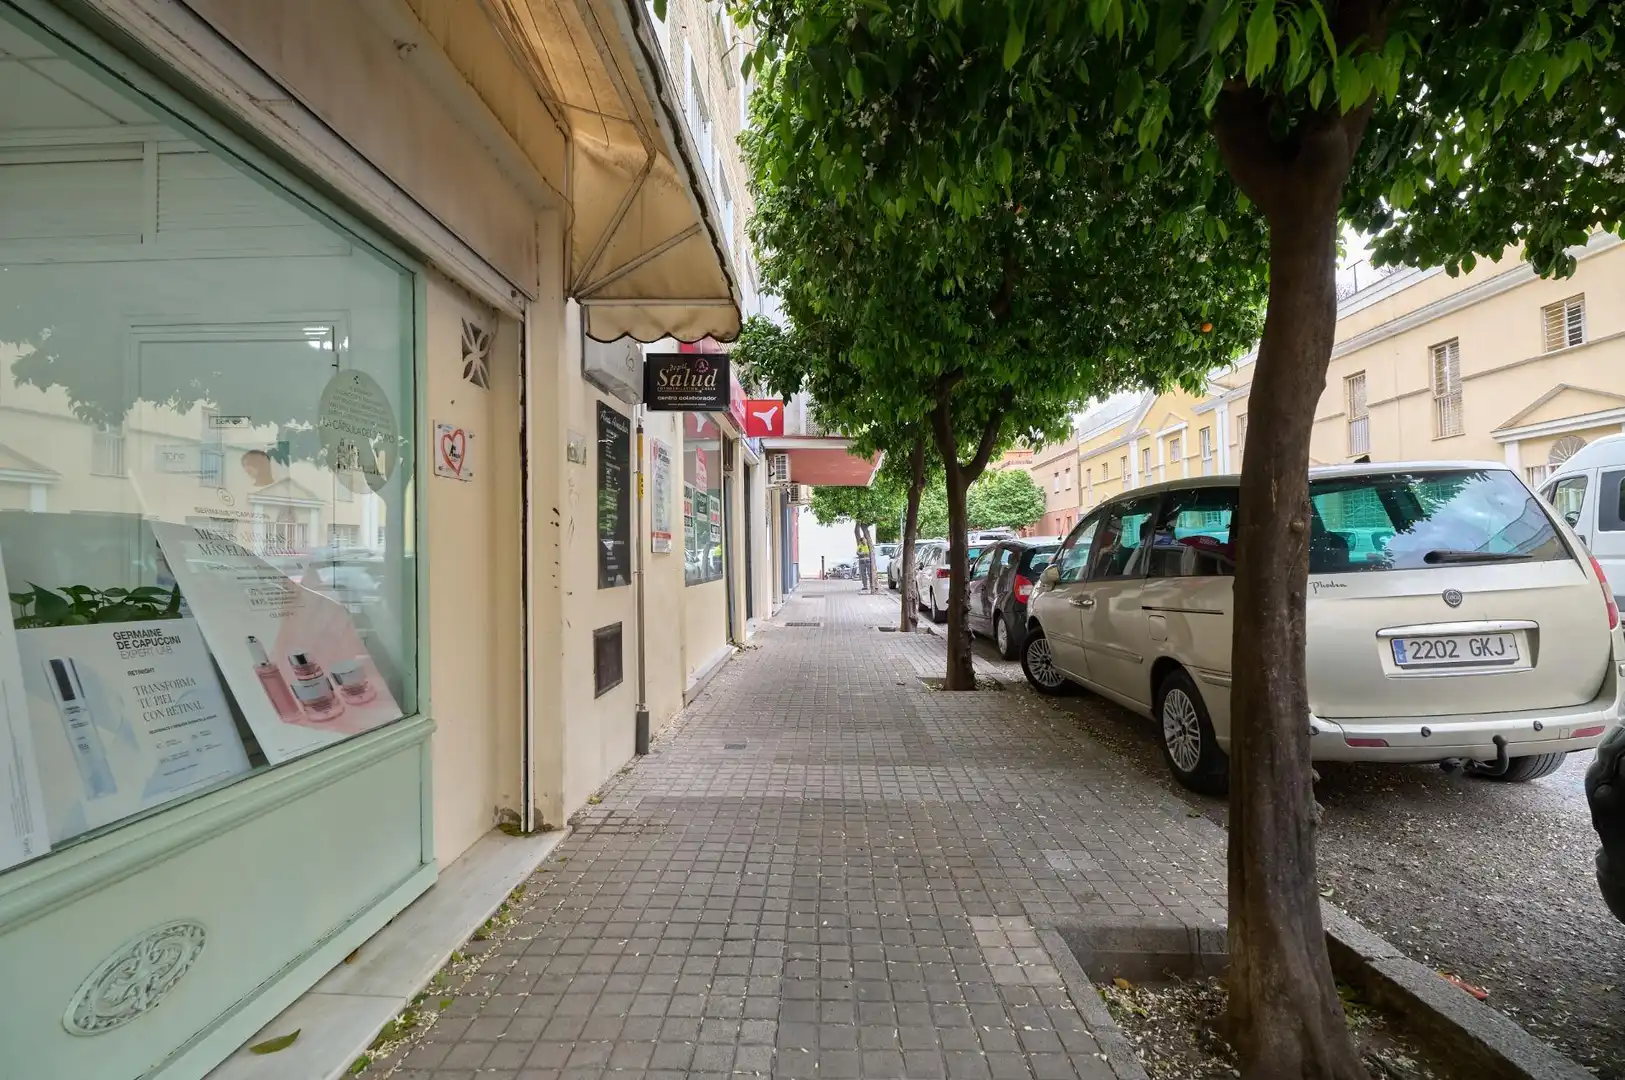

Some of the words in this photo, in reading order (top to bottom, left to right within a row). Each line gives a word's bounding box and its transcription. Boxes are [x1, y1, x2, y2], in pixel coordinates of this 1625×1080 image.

[657, 368, 718, 387] Salud
[113, 628, 163, 641] GERMAINE
[116, 641, 131, 650] DE
[132, 636, 181, 649] CAPUCCINI
[120, 648, 154, 660] EXPERT
[1410, 639, 1460, 660] 2202
[1469, 636, 1505, 657] GKJ
[133, 677, 197, 696] TRANSFORMA
[138, 696, 153, 709] TU
[155, 693, 176, 706] PIEL
[143, 709, 165, 722] CON
[166, 700, 205, 717] RETINAL
